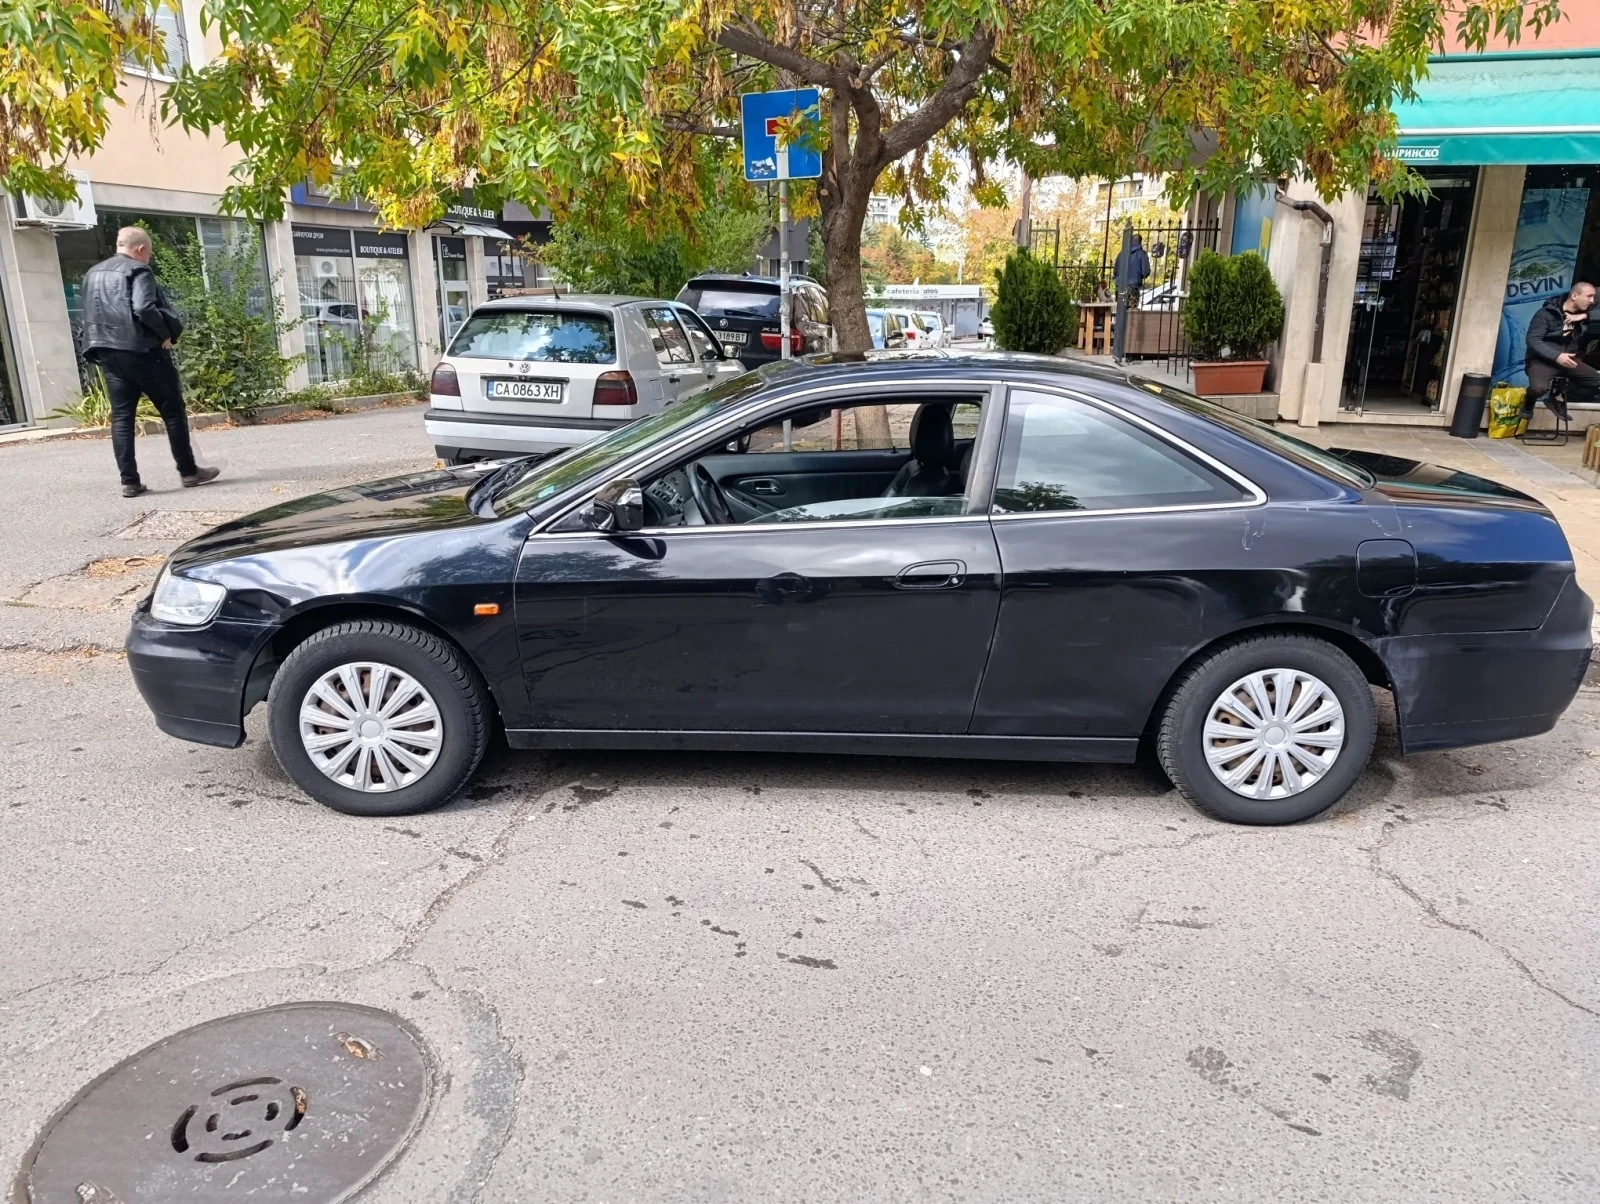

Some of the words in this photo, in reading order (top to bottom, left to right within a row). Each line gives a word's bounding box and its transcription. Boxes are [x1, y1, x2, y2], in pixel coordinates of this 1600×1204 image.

[360, 245, 383, 256] BOUTIQUE
[388, 247, 404, 255] ATELIER
[886, 287, 920, 295] cafeteria
[1506, 275, 1563, 298] DEVIN
[495, 383, 510, 396] CA
[512, 383, 541, 397] 0863
[543, 384, 559, 398] XH
